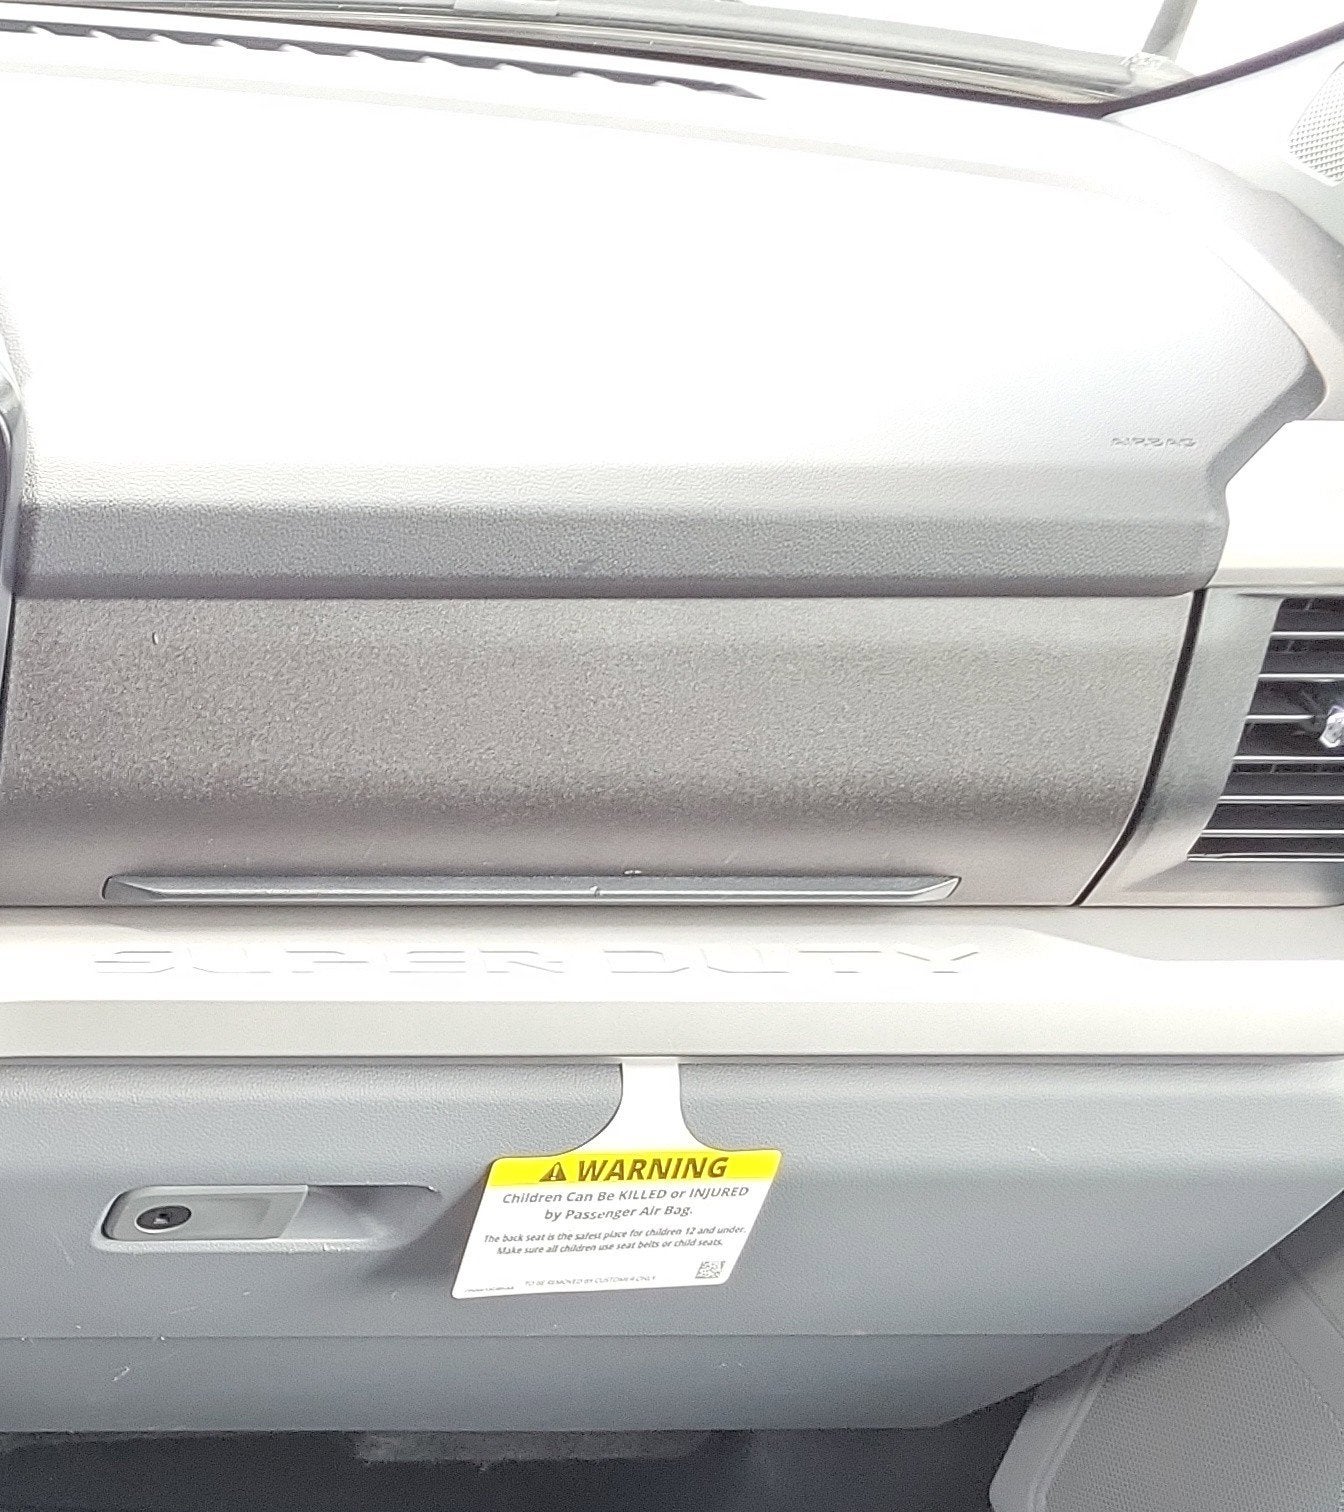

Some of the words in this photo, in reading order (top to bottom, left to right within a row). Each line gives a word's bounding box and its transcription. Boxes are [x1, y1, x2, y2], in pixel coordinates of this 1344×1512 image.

[92, 949, 568, 975] SUPER
[600, 949, 981, 975] DUTY
[578, 1156, 730, 1182] WARNING
[502, 1192, 564, 1204] Children
[566, 1191, 594, 1203] Can
[597, 1191, 615, 1202] Be
[618, 1189, 668, 1201] KILLED
[670, 1190, 687, 1199] or
[688, 1186, 750, 1199] INJURED
[544, 1208, 562, 1221] by
[565, 1206, 638, 1220] Passenger
[641, 1205, 662, 1217] Air
[664, 1205, 694, 1217] Bag.
[484, 1234, 501, 1243] The
[502, 1233, 524, 1243] back
[526, 1233, 546, 1242] seat
[547, 1232, 556, 1241] is
[557, 1231, 573, 1241] the
[574, 1231, 602, 1241] safest
[602, 1230, 628, 1241] place
[629, 1228, 644, 1238] for
[645, 1227, 683, 1238] children
[685, 1226, 697, 1236] 12
[697, 1225, 717, 1235] and
[717, 1225, 747, 1234] under.
[496, 1245, 522, 1255] Make
[524, 1246, 545, 1254] sure
[545, 1244, 560, 1254] all
[559, 1243, 596, 1254] children
[616, 1241, 636, 1250] seat
[637, 1239, 660, 1249] belts
[661, 1240, 672, 1248] or
[673, 1238, 697, 1248] child
